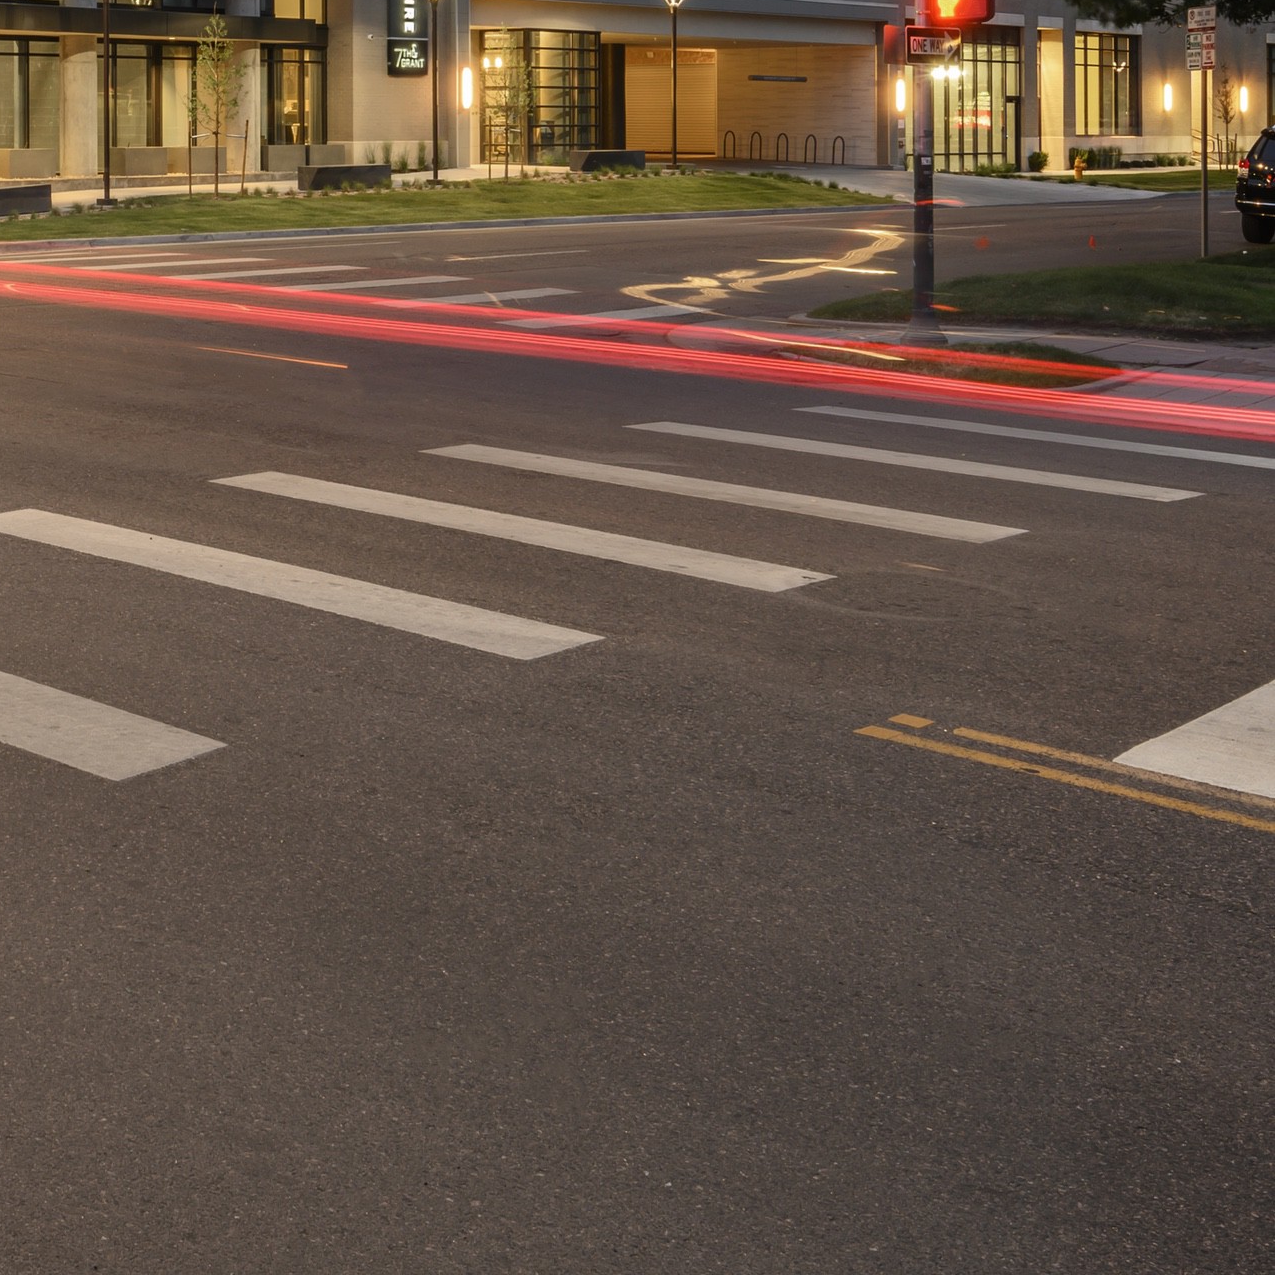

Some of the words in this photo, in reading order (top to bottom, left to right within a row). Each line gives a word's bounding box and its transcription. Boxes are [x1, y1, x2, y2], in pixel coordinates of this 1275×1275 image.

[912, 38, 928, 53] ONE
[929, 38, 945, 53] WAY
[400, 58, 425, 69] GRANT
